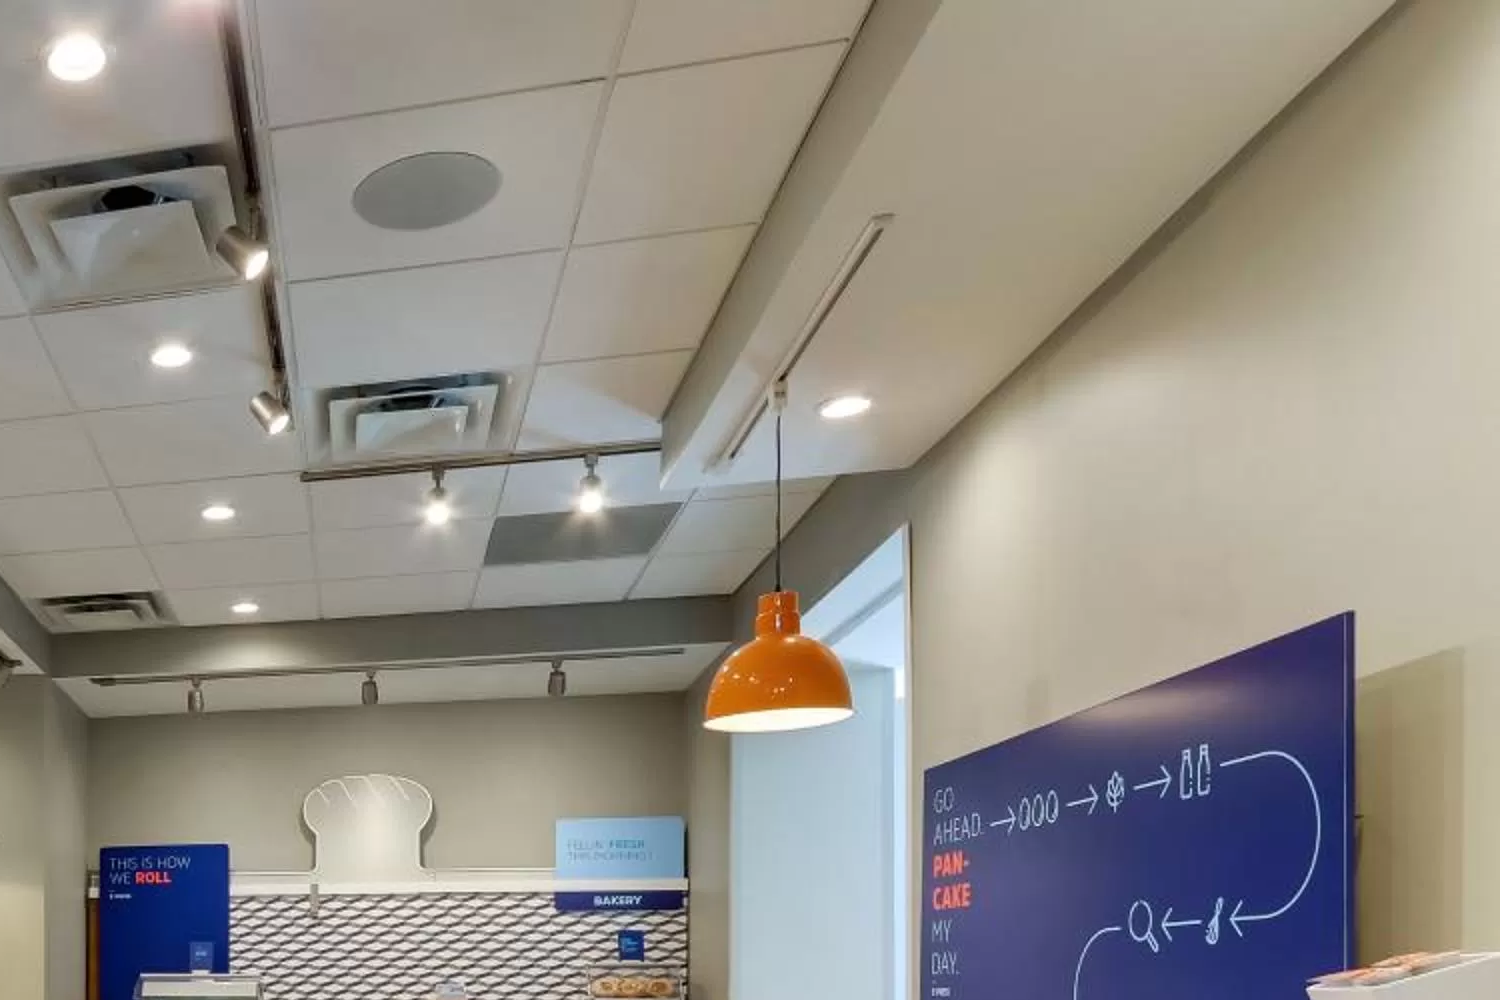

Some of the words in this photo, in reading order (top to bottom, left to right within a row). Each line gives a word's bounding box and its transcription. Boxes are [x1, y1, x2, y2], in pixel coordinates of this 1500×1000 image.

[933, 787, 955, 813] GO
[109, 857, 138, 870] THIS
[141, 856, 153, 869] IS
[157, 855, 191, 869] HOW
[933, 851, 970, 879] PAN-
[109, 871, 131, 885] WE
[135, 871, 173, 885] ROLL
[593, 895, 643, 907] BAKERY
[933, 883, 972, 911] CAKE
[932, 919, 952, 943] MY
